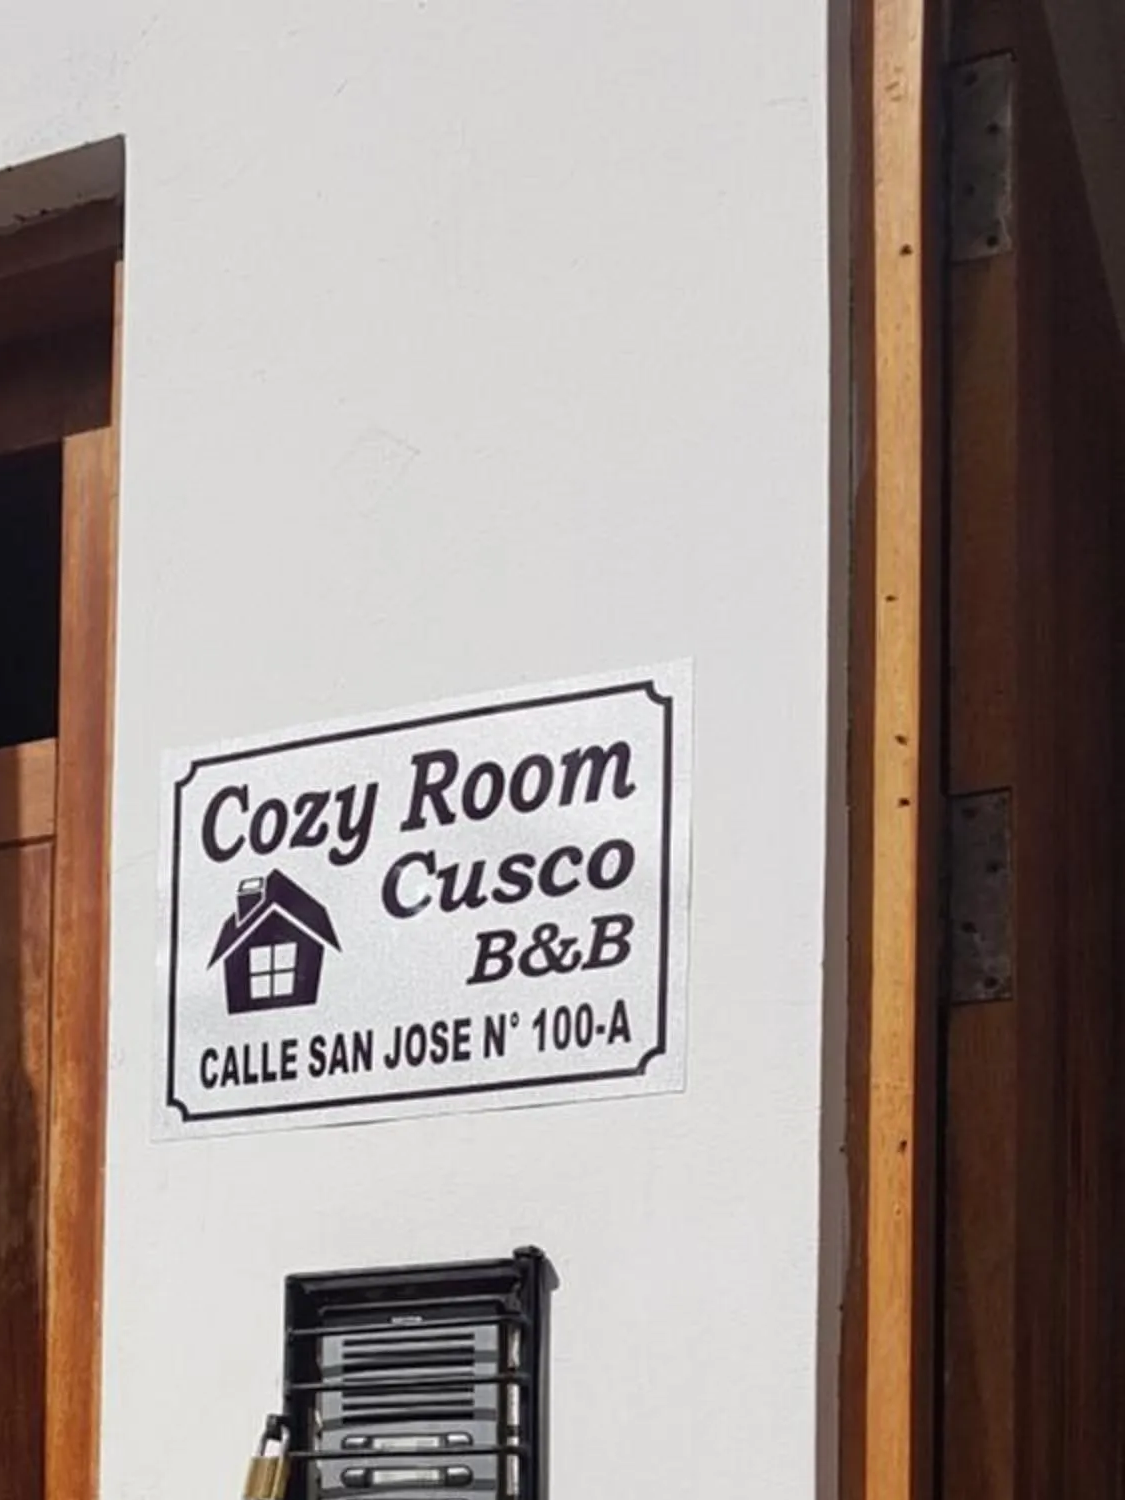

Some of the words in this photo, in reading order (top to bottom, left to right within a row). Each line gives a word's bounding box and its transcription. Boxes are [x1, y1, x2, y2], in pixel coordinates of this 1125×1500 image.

[202, 782, 379, 866] Cozy
[400, 740, 636, 833] Room
[381, 839, 635, 919] Cusco
[466, 914, 634, 985] B&B
[200, 1039, 297, 1090] CALLE
[308, 1030, 372, 1077] SAN
[384, 1019, 471, 1070] JOSE
[532, 999, 631, 1052] 100-A
